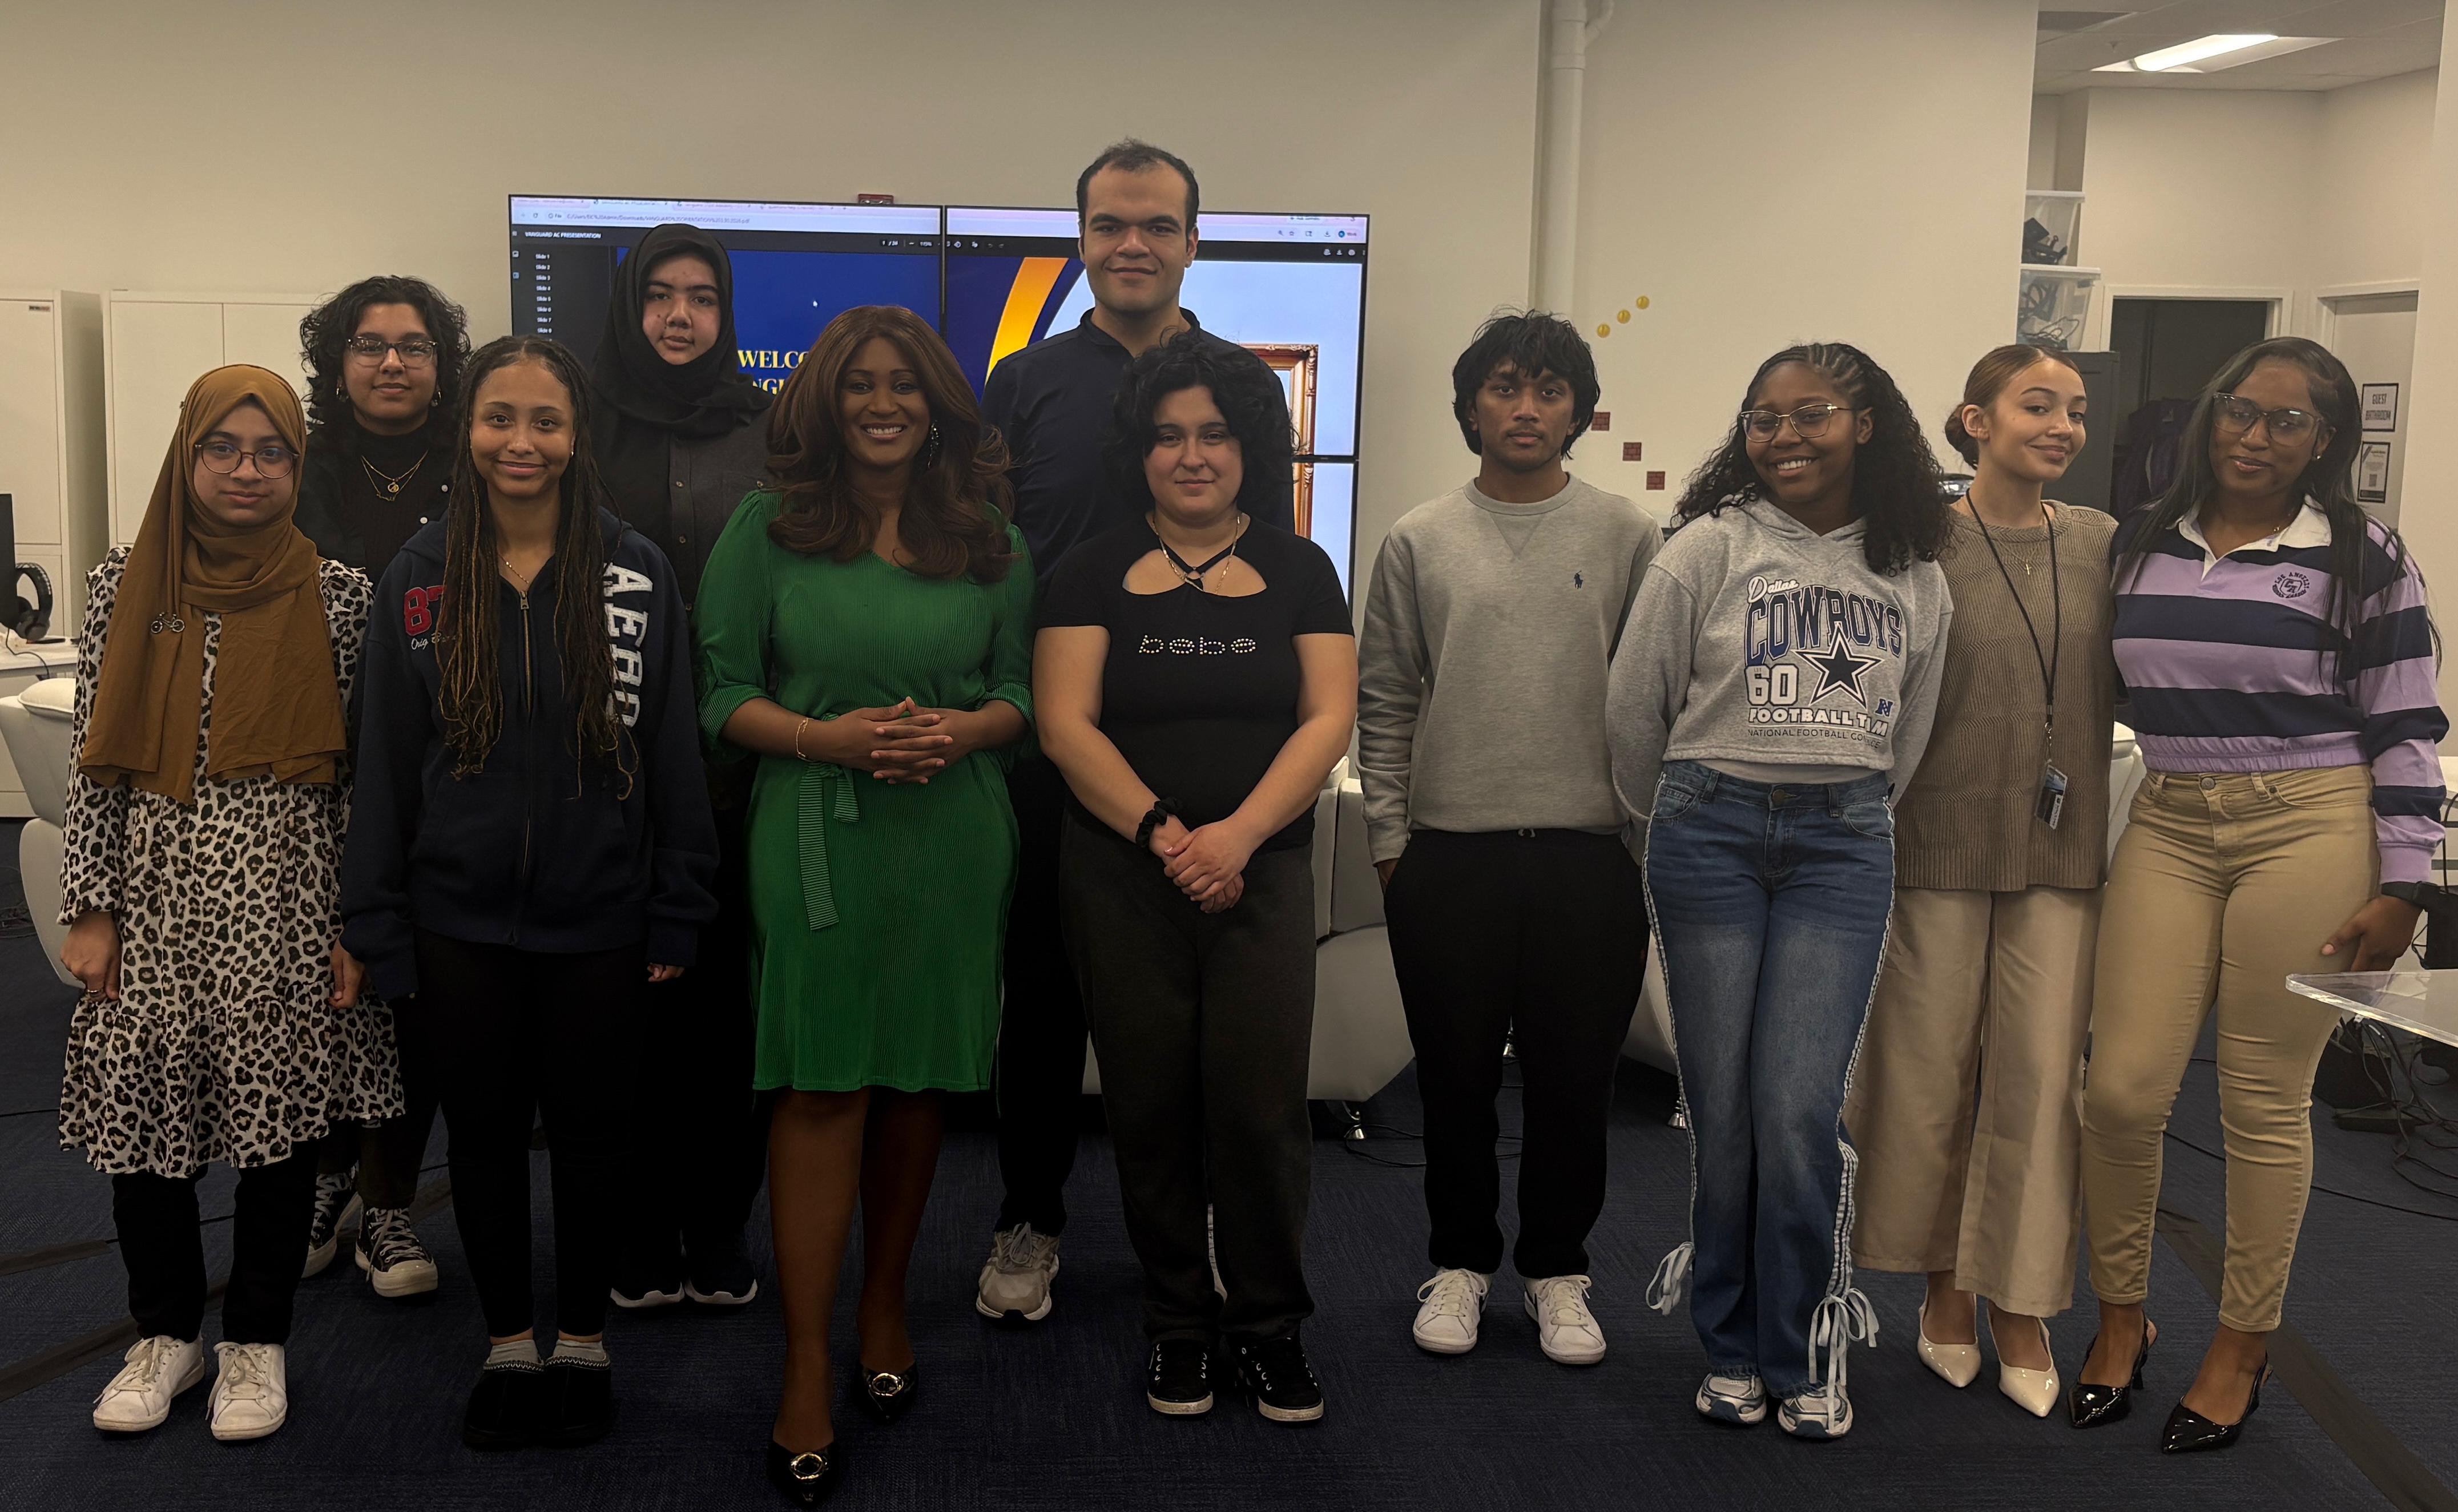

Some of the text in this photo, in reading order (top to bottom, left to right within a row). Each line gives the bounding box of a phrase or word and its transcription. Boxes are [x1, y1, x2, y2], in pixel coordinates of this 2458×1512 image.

[2372, 393, 2387, 405] GUEST
[1747, 575, 1799, 603] Dallas
[1139, 635, 1256, 655] bebe
[1743, 663, 1799, 707] 60
[1748, 707, 1854, 727] FOOTBALL
[1797, 728, 1848, 739] FOOTBALL
